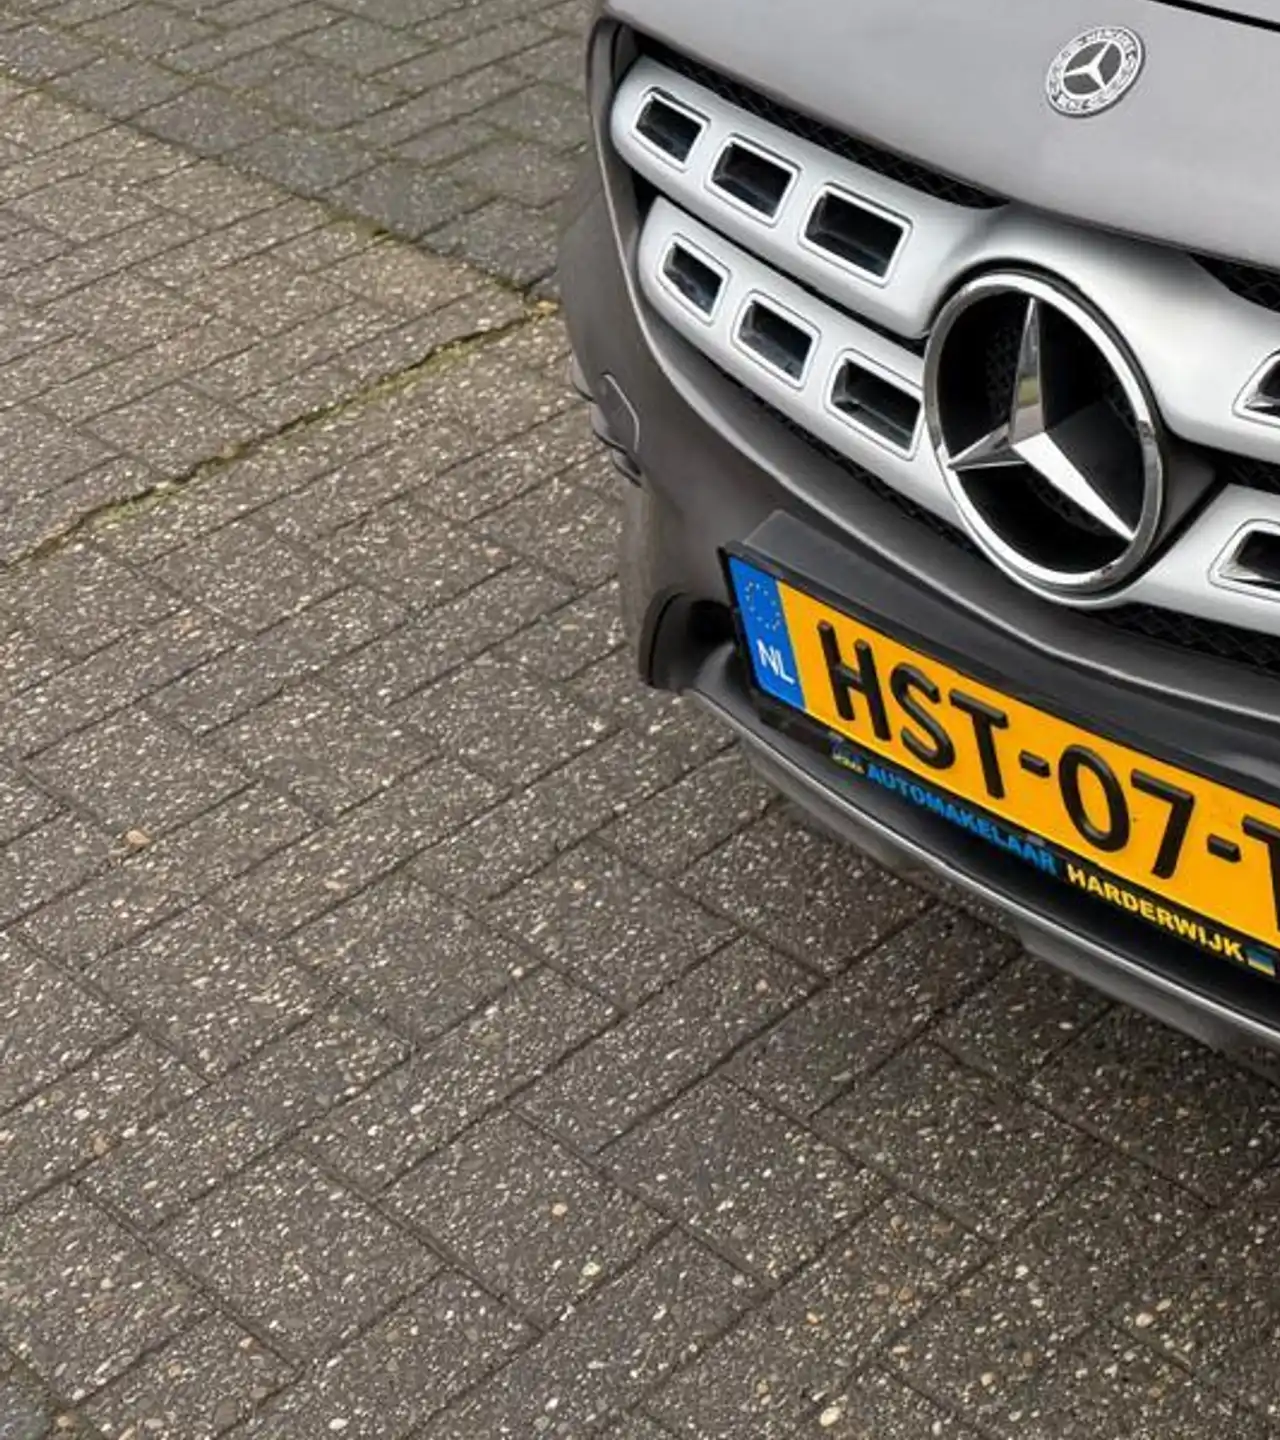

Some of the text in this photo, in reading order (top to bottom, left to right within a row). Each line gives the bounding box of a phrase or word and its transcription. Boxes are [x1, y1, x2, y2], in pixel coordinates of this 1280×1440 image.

[756, 640, 796, 685] NL
[866, 762, 1246, 961] AUTOMAKELAAR HARDERWIJK
